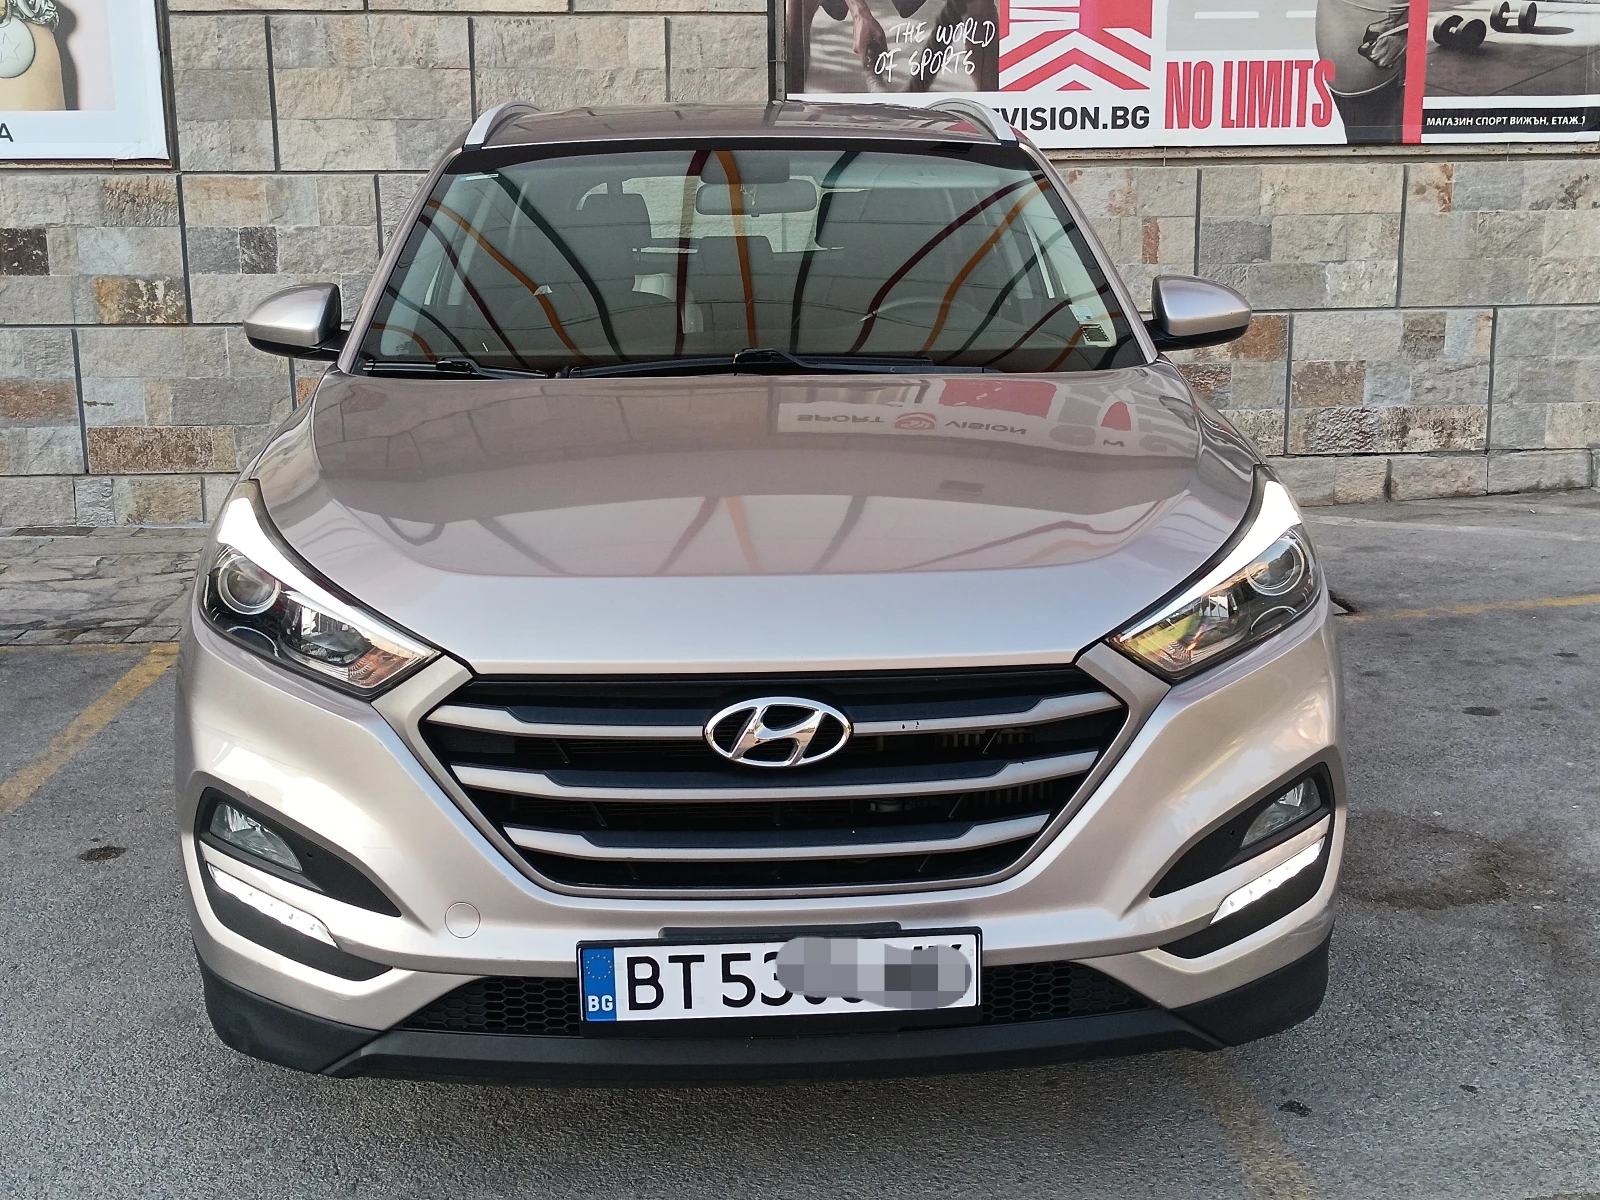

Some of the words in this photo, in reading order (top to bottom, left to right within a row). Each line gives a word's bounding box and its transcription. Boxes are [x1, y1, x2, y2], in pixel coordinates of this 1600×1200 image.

[889, 21, 927, 43] THE
[936, 17, 996, 47] WORLD
[874, 48, 901, 82] OF
[908, 46, 976, 80] SPORTS
[1165, 60, 1215, 129] NO
[1221, 59, 1335, 128] LIMITS
[993, 106, 1150, 131] VISION.BG
[1426, 116, 1473, 126] МАГАЗИН
[1475, 116, 1508, 126] СПОРТ
[1509, 116, 1549, 126] ВИЖЪН,
[1551, 116, 1578, 125] ЕТАЖ
[626, 954, 705, 1011] BT
[588, 995, 613, 1012] BG
